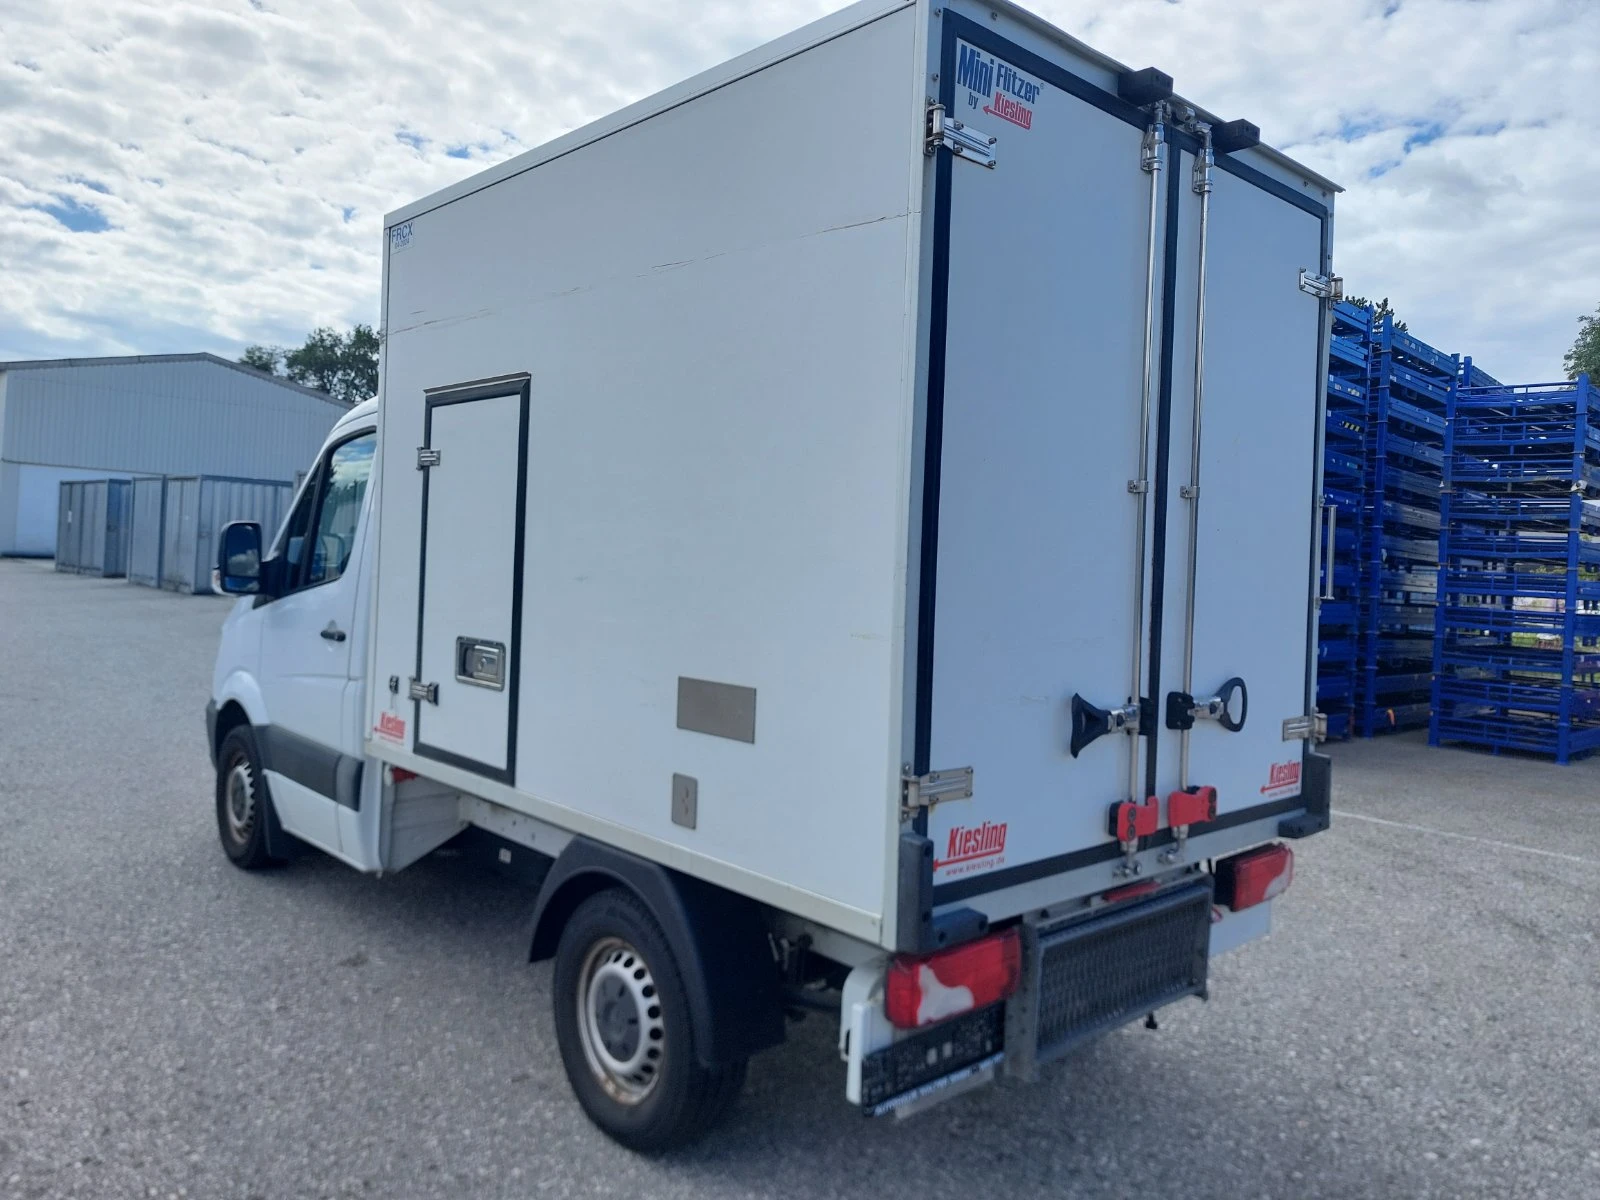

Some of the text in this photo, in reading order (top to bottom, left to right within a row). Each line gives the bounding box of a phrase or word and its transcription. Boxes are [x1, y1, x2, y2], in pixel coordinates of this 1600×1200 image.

[957, 43, 1040, 105] Mini Flitzer
[968, 90, 1033, 129] by Kiesling
[391, 221, 413, 244] FRCX
[947, 820, 1007, 859] Kiesling
